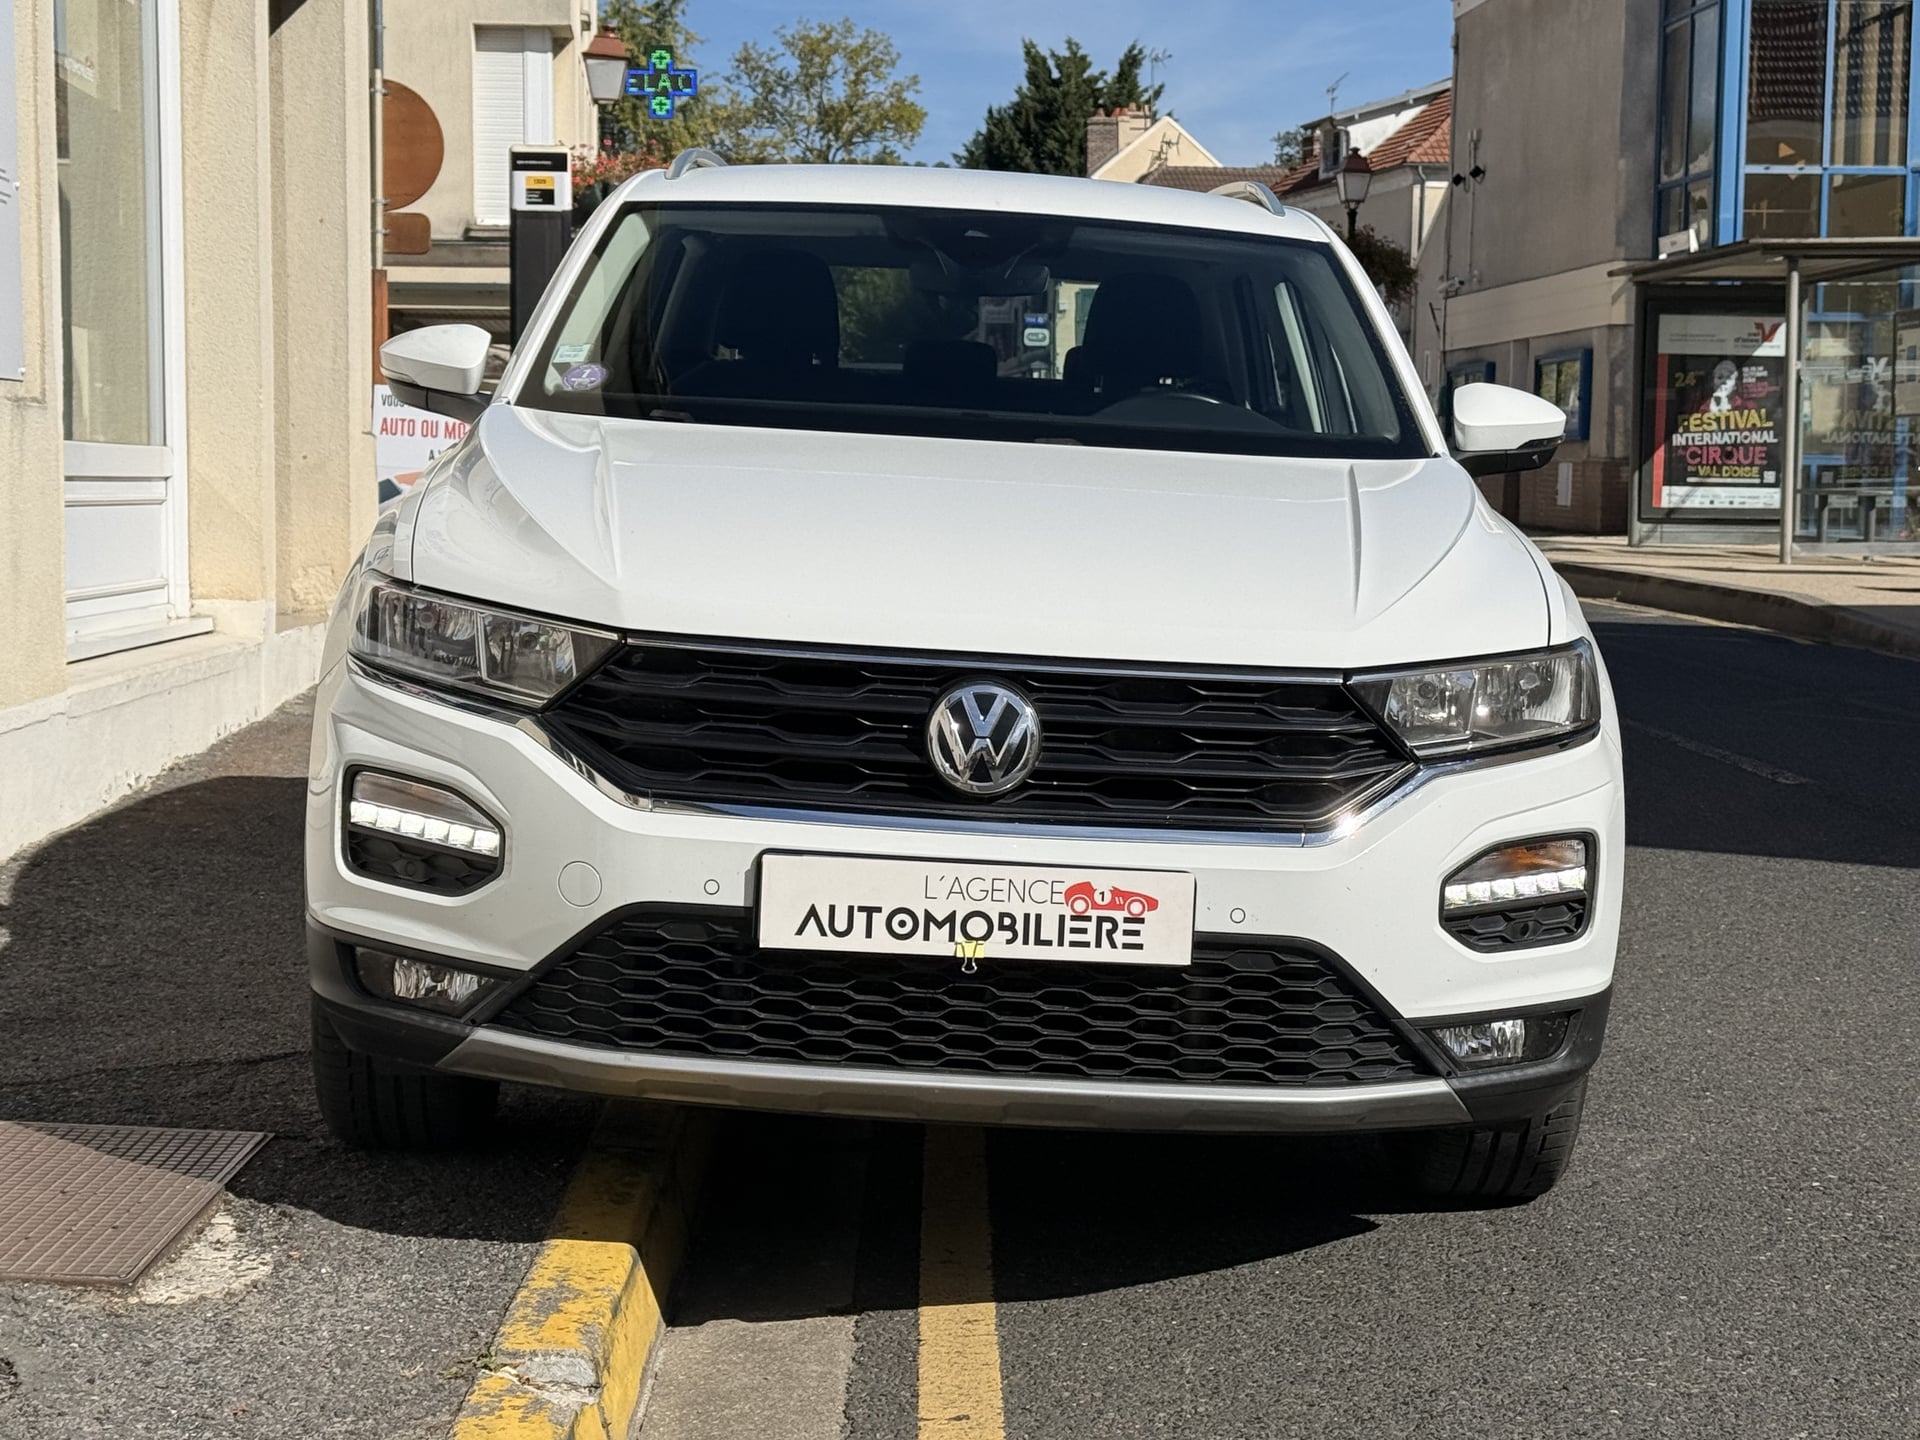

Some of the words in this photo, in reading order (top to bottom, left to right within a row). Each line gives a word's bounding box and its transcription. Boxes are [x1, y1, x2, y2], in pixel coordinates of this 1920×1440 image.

[380, 417, 416, 437] AUTO
[420, 420, 438, 438] OU
[1679, 408, 1774, 433] FESTIVAL
[1672, 430, 1779, 446] INTERNATIONAL
[428, 449, 435, 461] A
[1685, 446, 1768, 465] CIRQUE
[1698, 465, 1720, 477] VAL
[1722, 466, 1760, 478] D'OISE
[924, 874, 1066, 905] L'AGENCE
[1099, 891, 1105, 902] 1
[794, 903, 1146, 950] AUTOMOBILIERE
